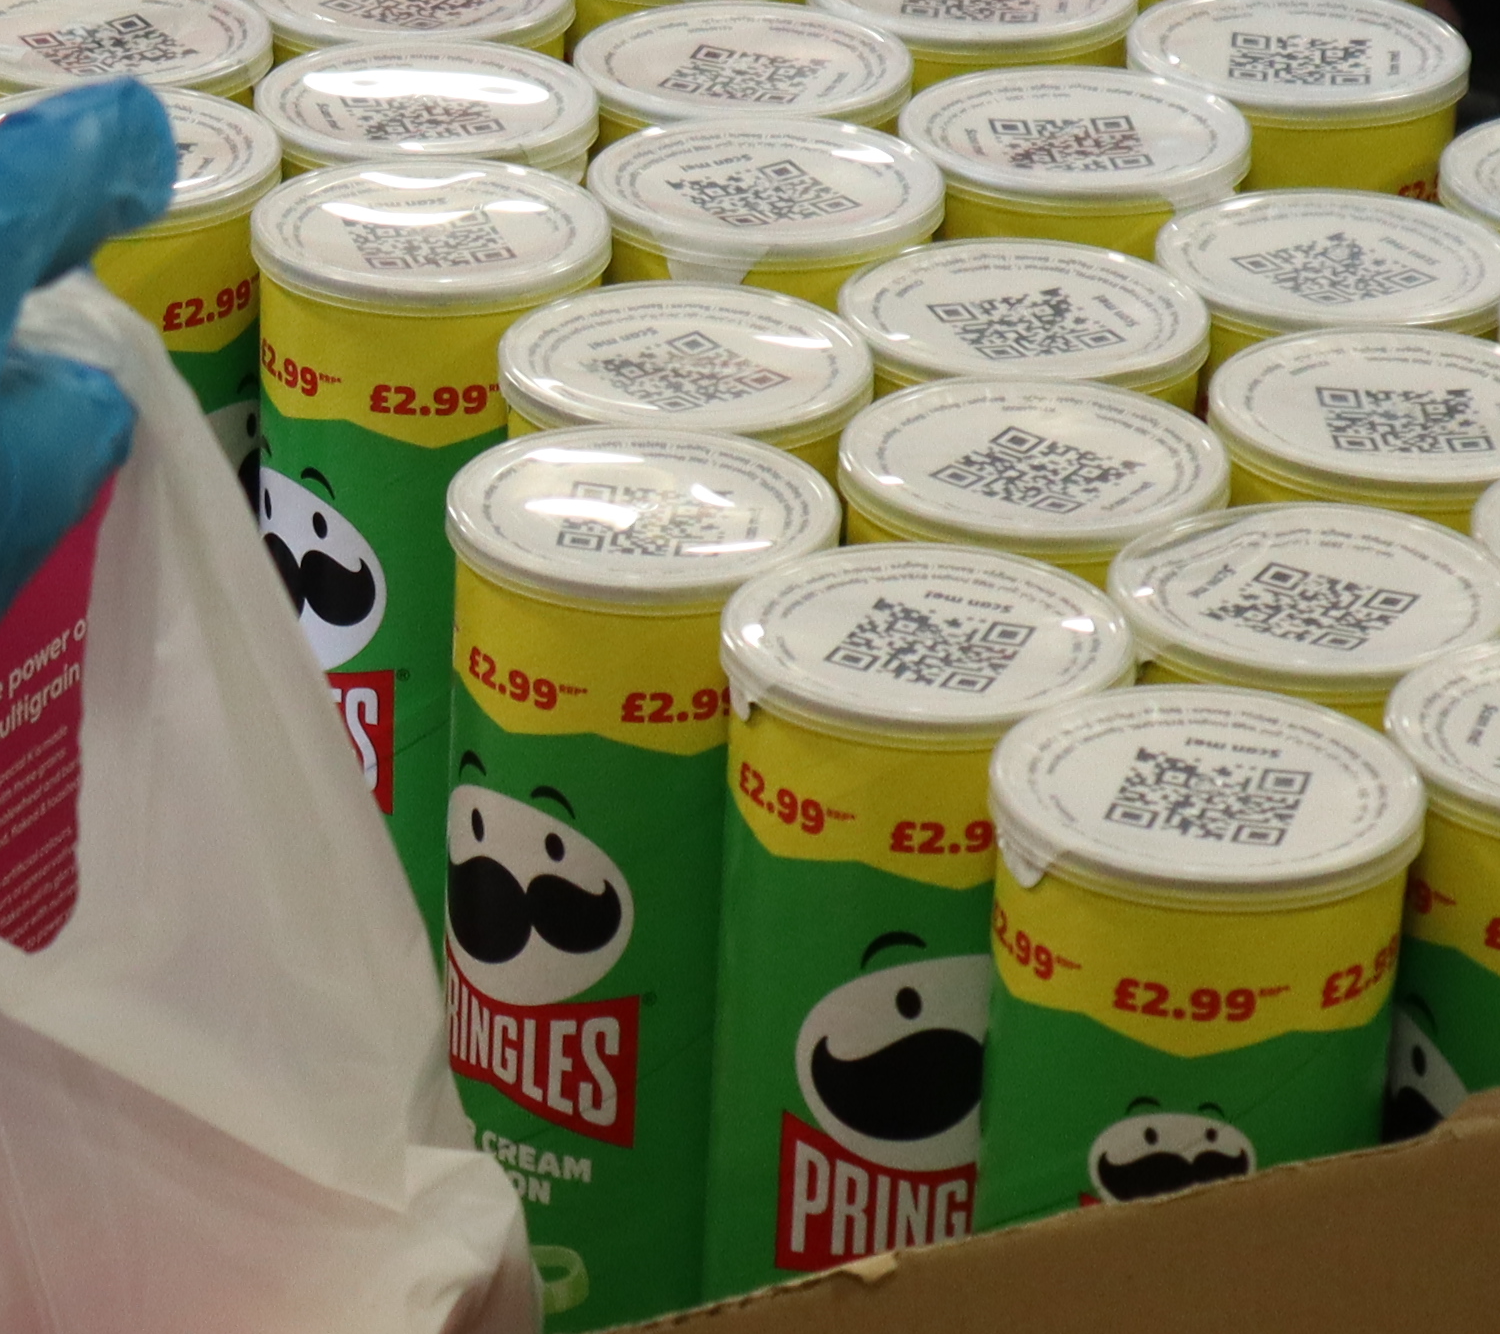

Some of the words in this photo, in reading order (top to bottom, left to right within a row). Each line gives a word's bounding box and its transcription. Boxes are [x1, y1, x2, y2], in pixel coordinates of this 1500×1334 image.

[163, 280, 252, 333] £2.99
[369, 384, 488, 417] £2.99
[967, 600, 1014, 615] Scan
[9, 629, 71, 699] power
[468, 646, 559, 711] £2.99
[1185, 736, 1229, 752] me!
[1232, 742, 1282, 759] Scan
[739, 762, 825, 835] £2.99
[890, 819, 996, 855] £2.9
[1112, 976, 1258, 1022] £2.99
[447, 971, 623, 1129] RINGLES
[482, 1131, 593, 1184] CREAM
[791, 1139, 968, 1256] PRING
